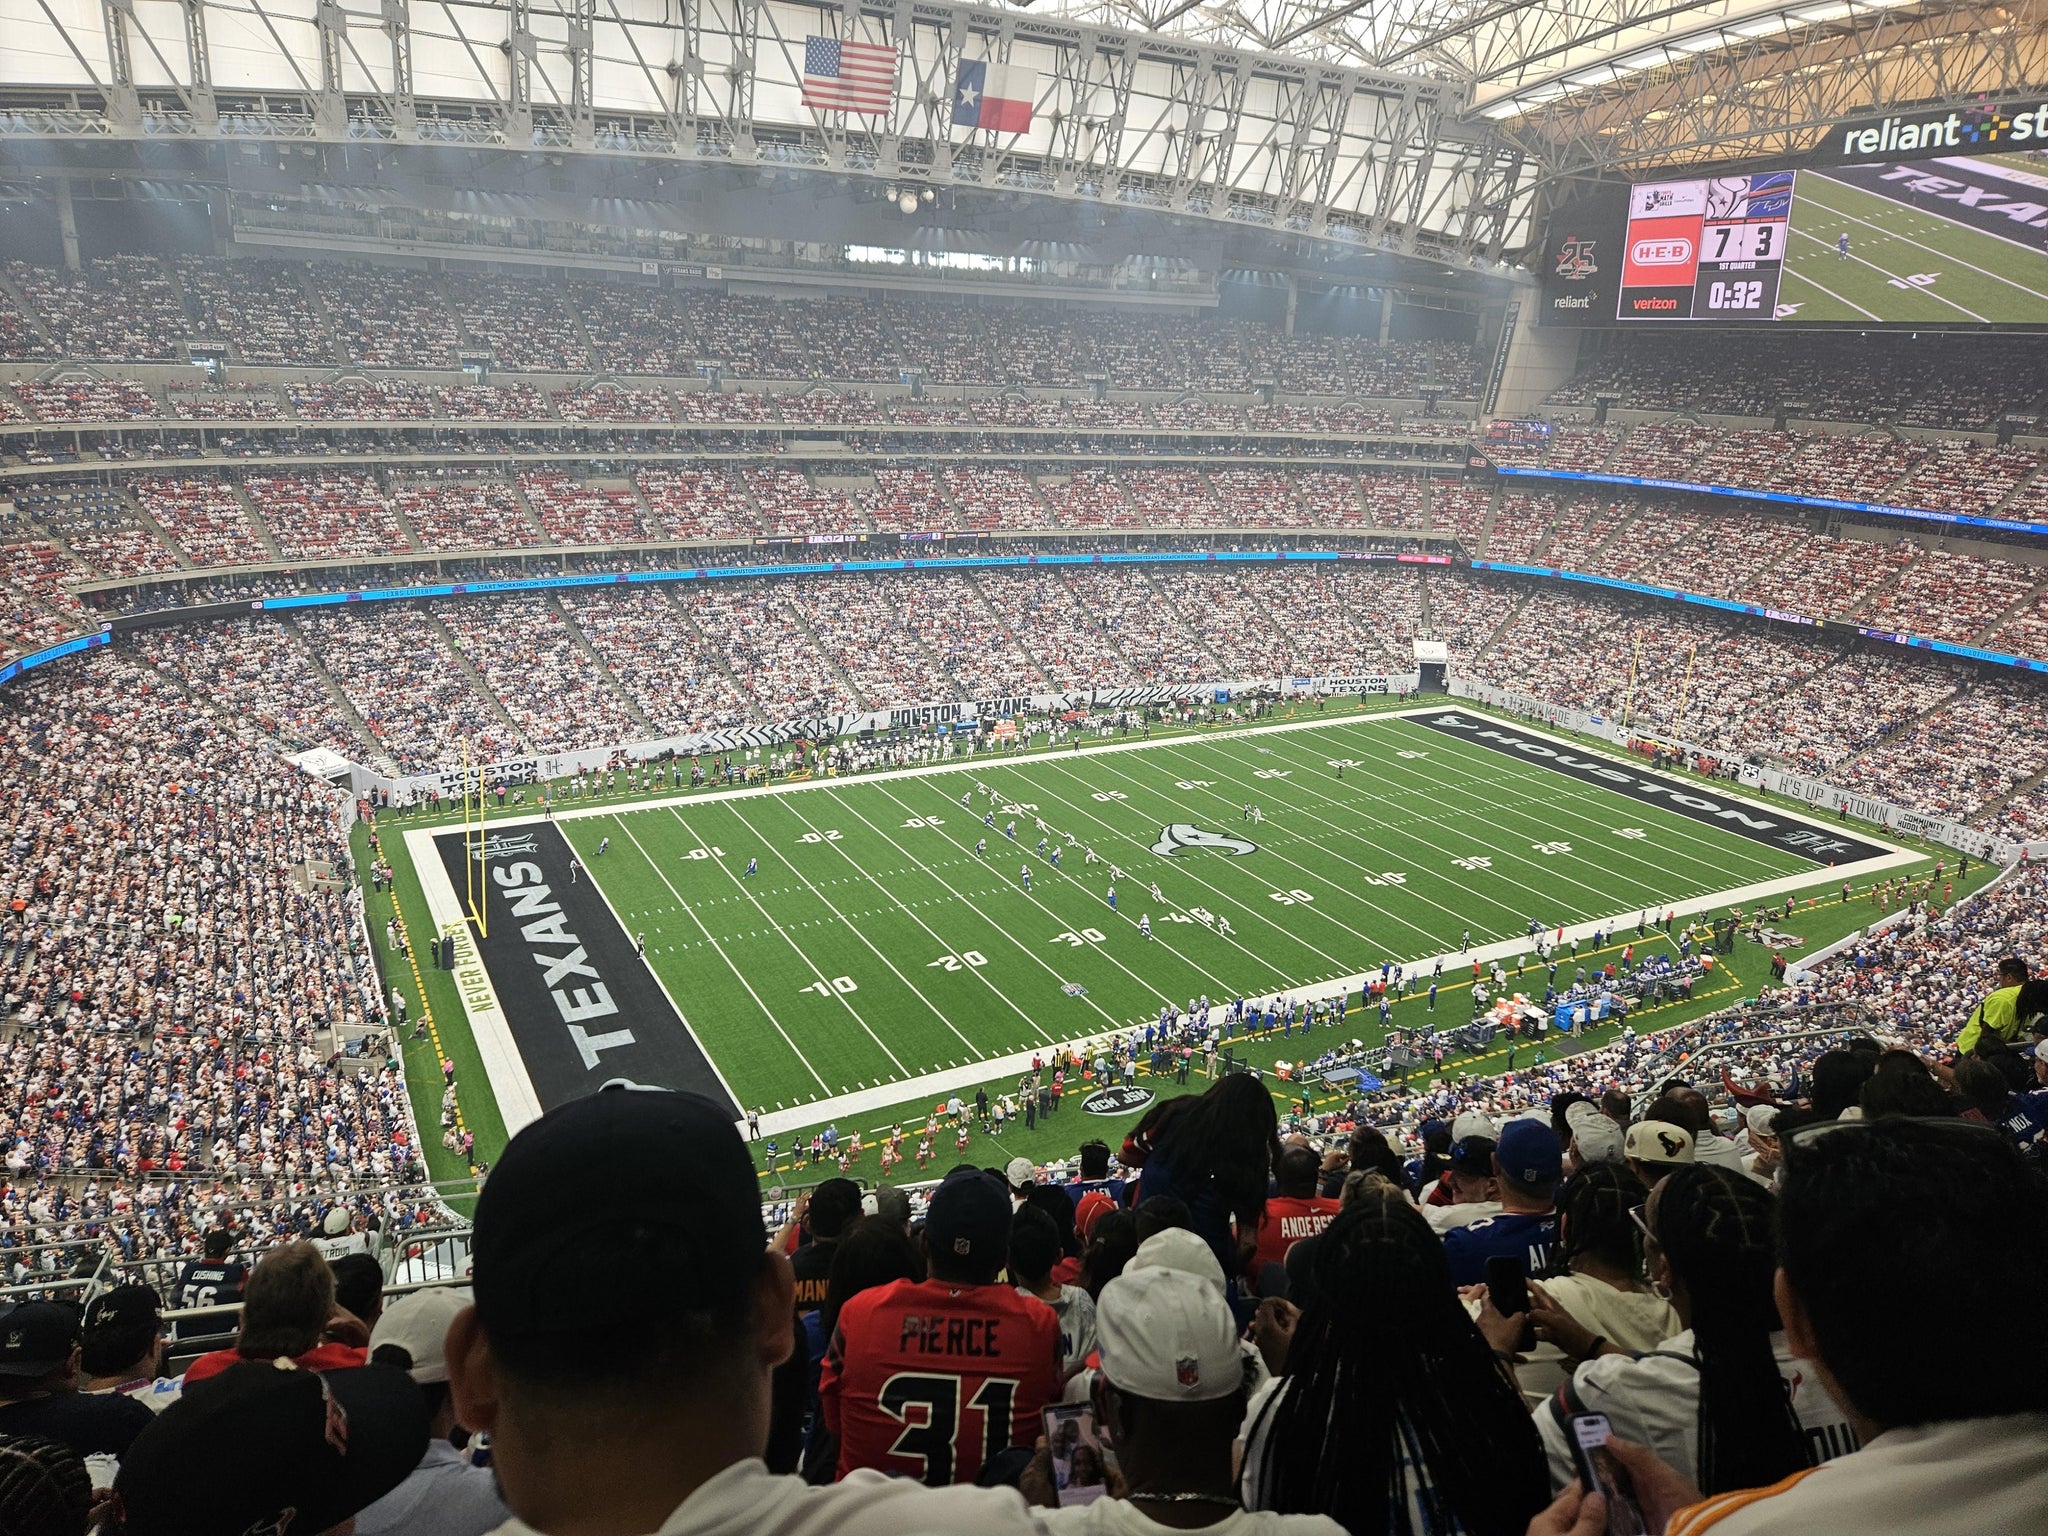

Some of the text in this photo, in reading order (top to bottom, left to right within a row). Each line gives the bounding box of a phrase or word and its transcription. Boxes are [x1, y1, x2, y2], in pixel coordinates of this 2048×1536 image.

[1843, 113, 1960, 154] reliant
[1878, 165, 2048, 228] TEXA
[1714, 226, 1773, 258] 7 3
[1719, 261, 1756, 270] 1ST QUARTER
[1887, 273, 1937, 289] 10
[1554, 296, 1590, 308] reliant
[1709, 281, 1763, 309] 0:32
[1633, 297, 1677, 310] verizon
[1930, 512, 1956, 521] TICKETS!
[407, 588, 432, 596] LOTTERY
[1945, 645, 1996, 660] TEXAS LOTTERY
[1330, 685, 1387, 693] TEXANS
[891, 704, 962, 726] HOUSTON
[975, 698, 1031, 716] TEXANS
[1396, 750, 1424, 759] 10
[440, 760, 538, 784] HOUSTON
[1326, 759, 1360, 769] 20
[1744, 766, 1758, 778] 25
[442, 768, 537, 795] TEXANS
[1252, 768, 1287, 779] 30
[1476, 731, 1778, 830] HOUSTON
[1175, 780, 1212, 790] 40
[1091, 791, 1128, 801] 50
[1805, 784, 1824, 801] UP
[1850, 797, 1889, 823] TOWN
[906, 815, 946, 828] 30
[1897, 820, 1923, 834] HUDDL
[1903, 814, 1946, 832] COMMUNITY
[801, 829, 844, 844] 20
[1612, 829, 1647, 840] 10
[689, 846, 726, 860] 10
[1532, 841, 1573, 855] 20
[1451, 856, 1493, 870] 30
[1364, 872, 1407, 886] 40
[1269, 889, 1314, 906] 50
[1170, 906, 1214, 925] 40
[442, 922, 475, 967] FORGET
[1060, 927, 1107, 947] 30
[492, 861, 636, 1071] TEXANS
[939, 950, 988, 971] 20
[462, 970, 495, 1013] NEVER
[812, 976, 858, 996] 10
[1086, 1089, 1151, 1113] RCM JSM
[2002, 1112, 2033, 1133] NOX
[320, 1246, 350, 1259] TROUD
[191, 1270, 226, 1281] CUSHING
[182, 1284, 218, 1308] 56
[902, 1316, 1000, 1357] PIERCE
[878, 1371, 1020, 1485] 31
